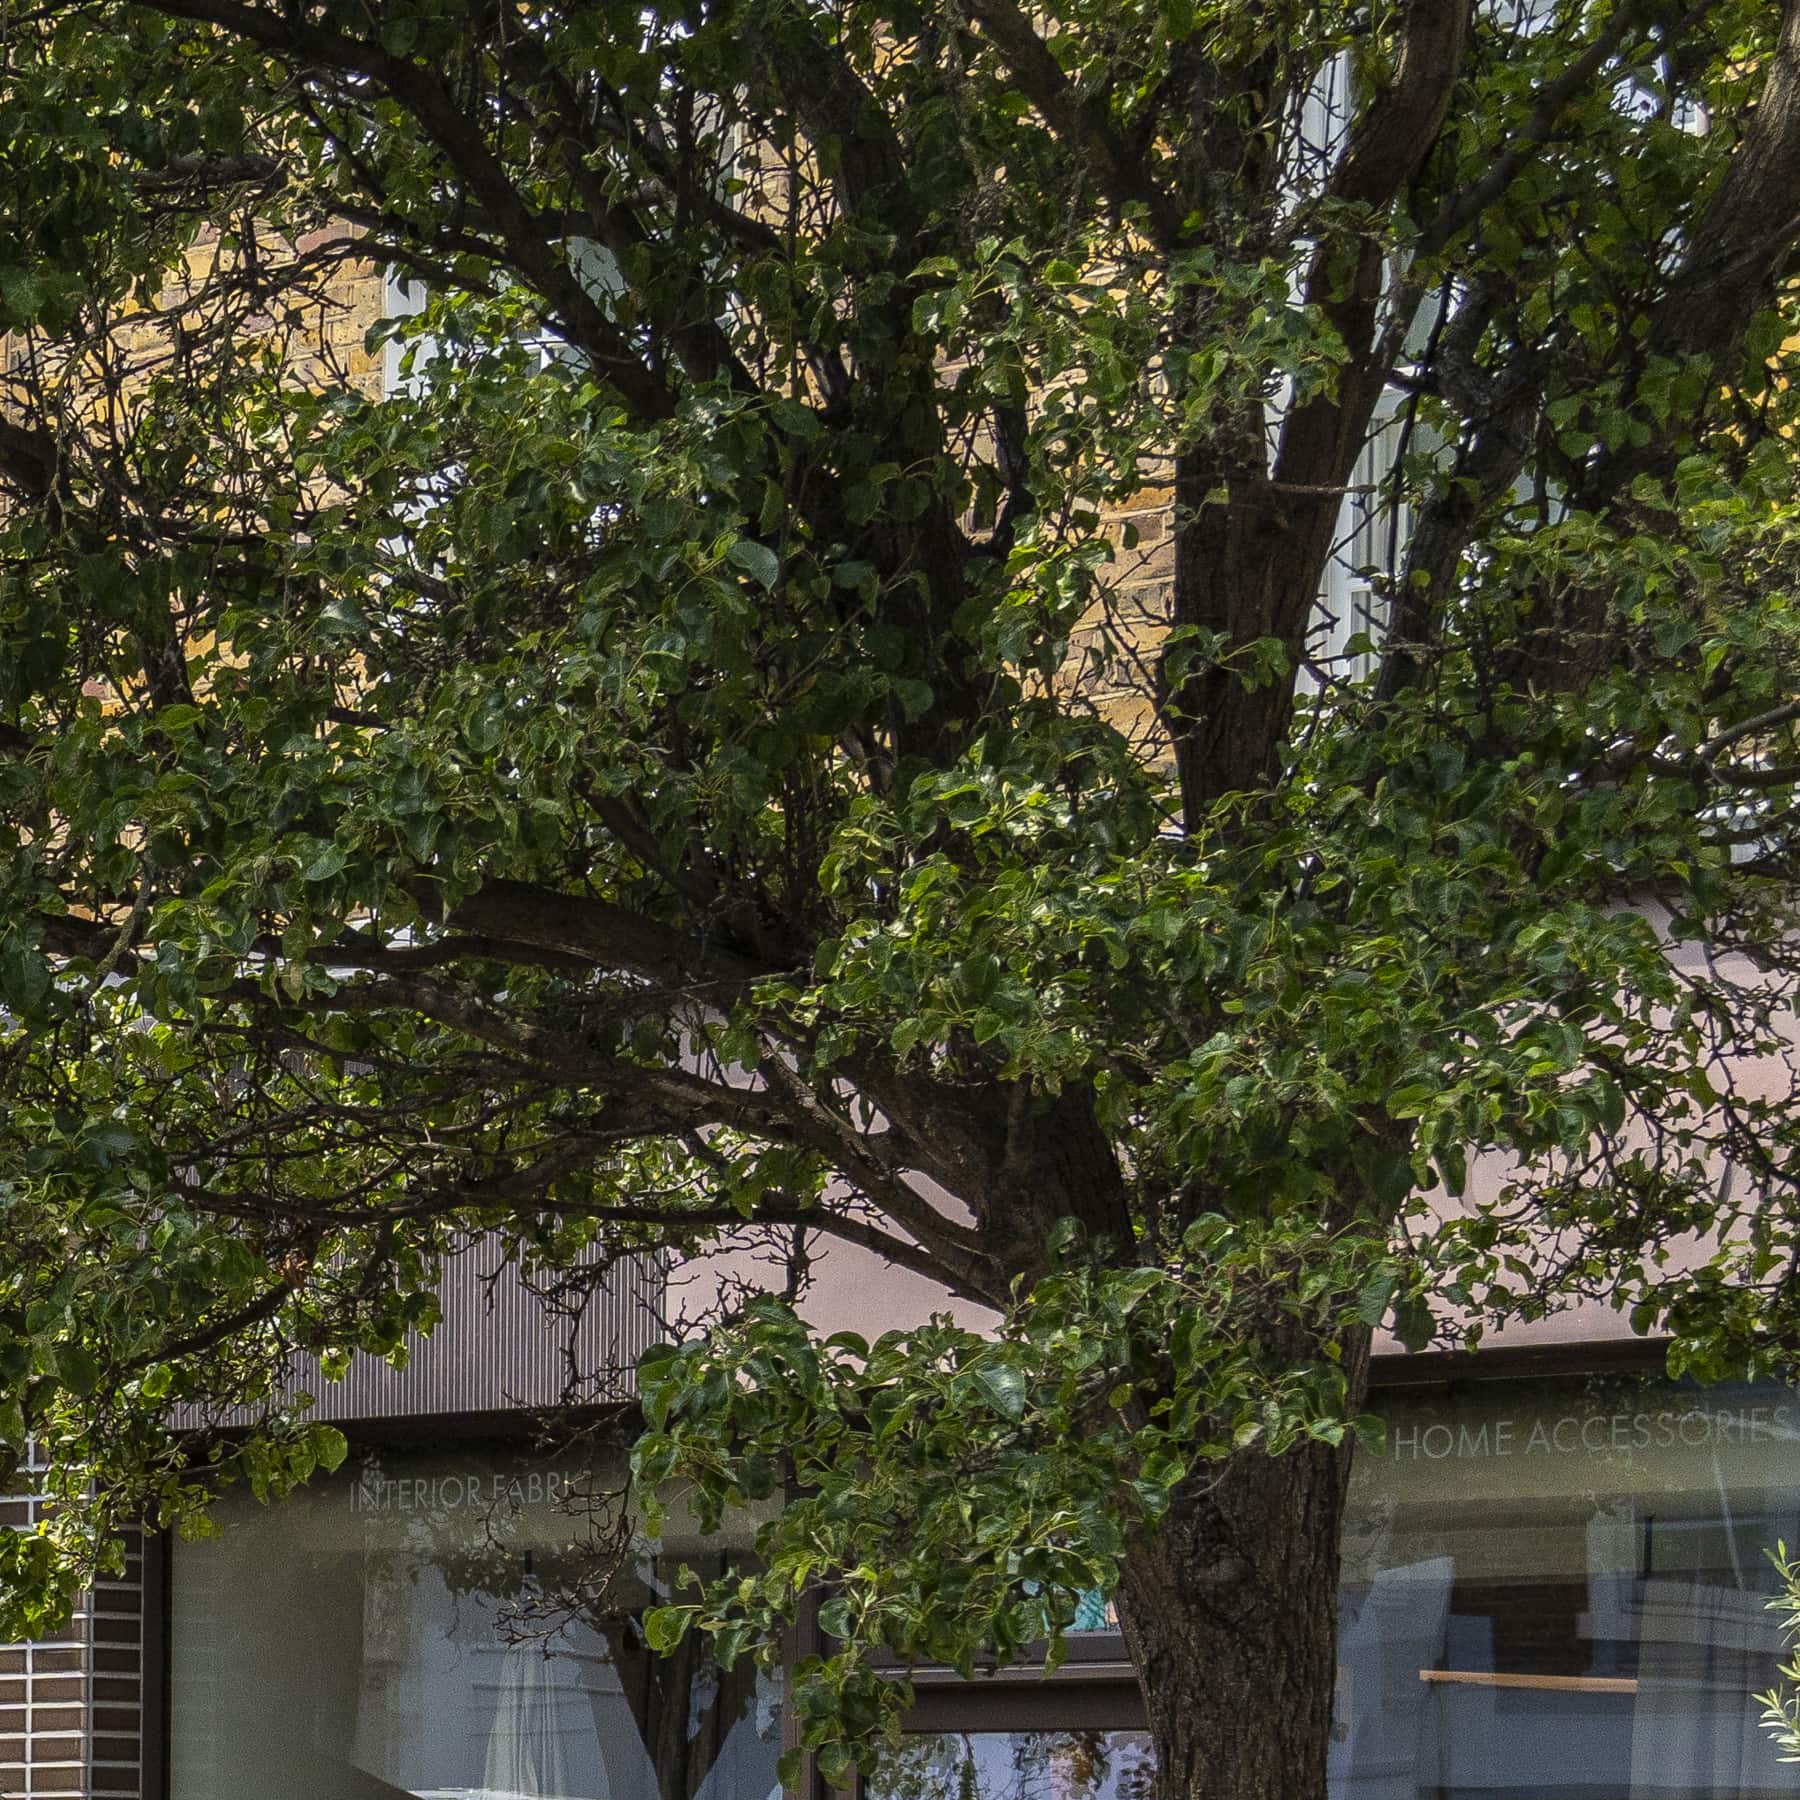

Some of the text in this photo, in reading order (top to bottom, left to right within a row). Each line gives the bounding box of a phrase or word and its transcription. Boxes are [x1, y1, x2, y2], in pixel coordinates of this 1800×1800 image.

[1394, 1406, 1791, 1461] HOME ACCESSORIES
[350, 1476, 482, 1512] INTERIOR
